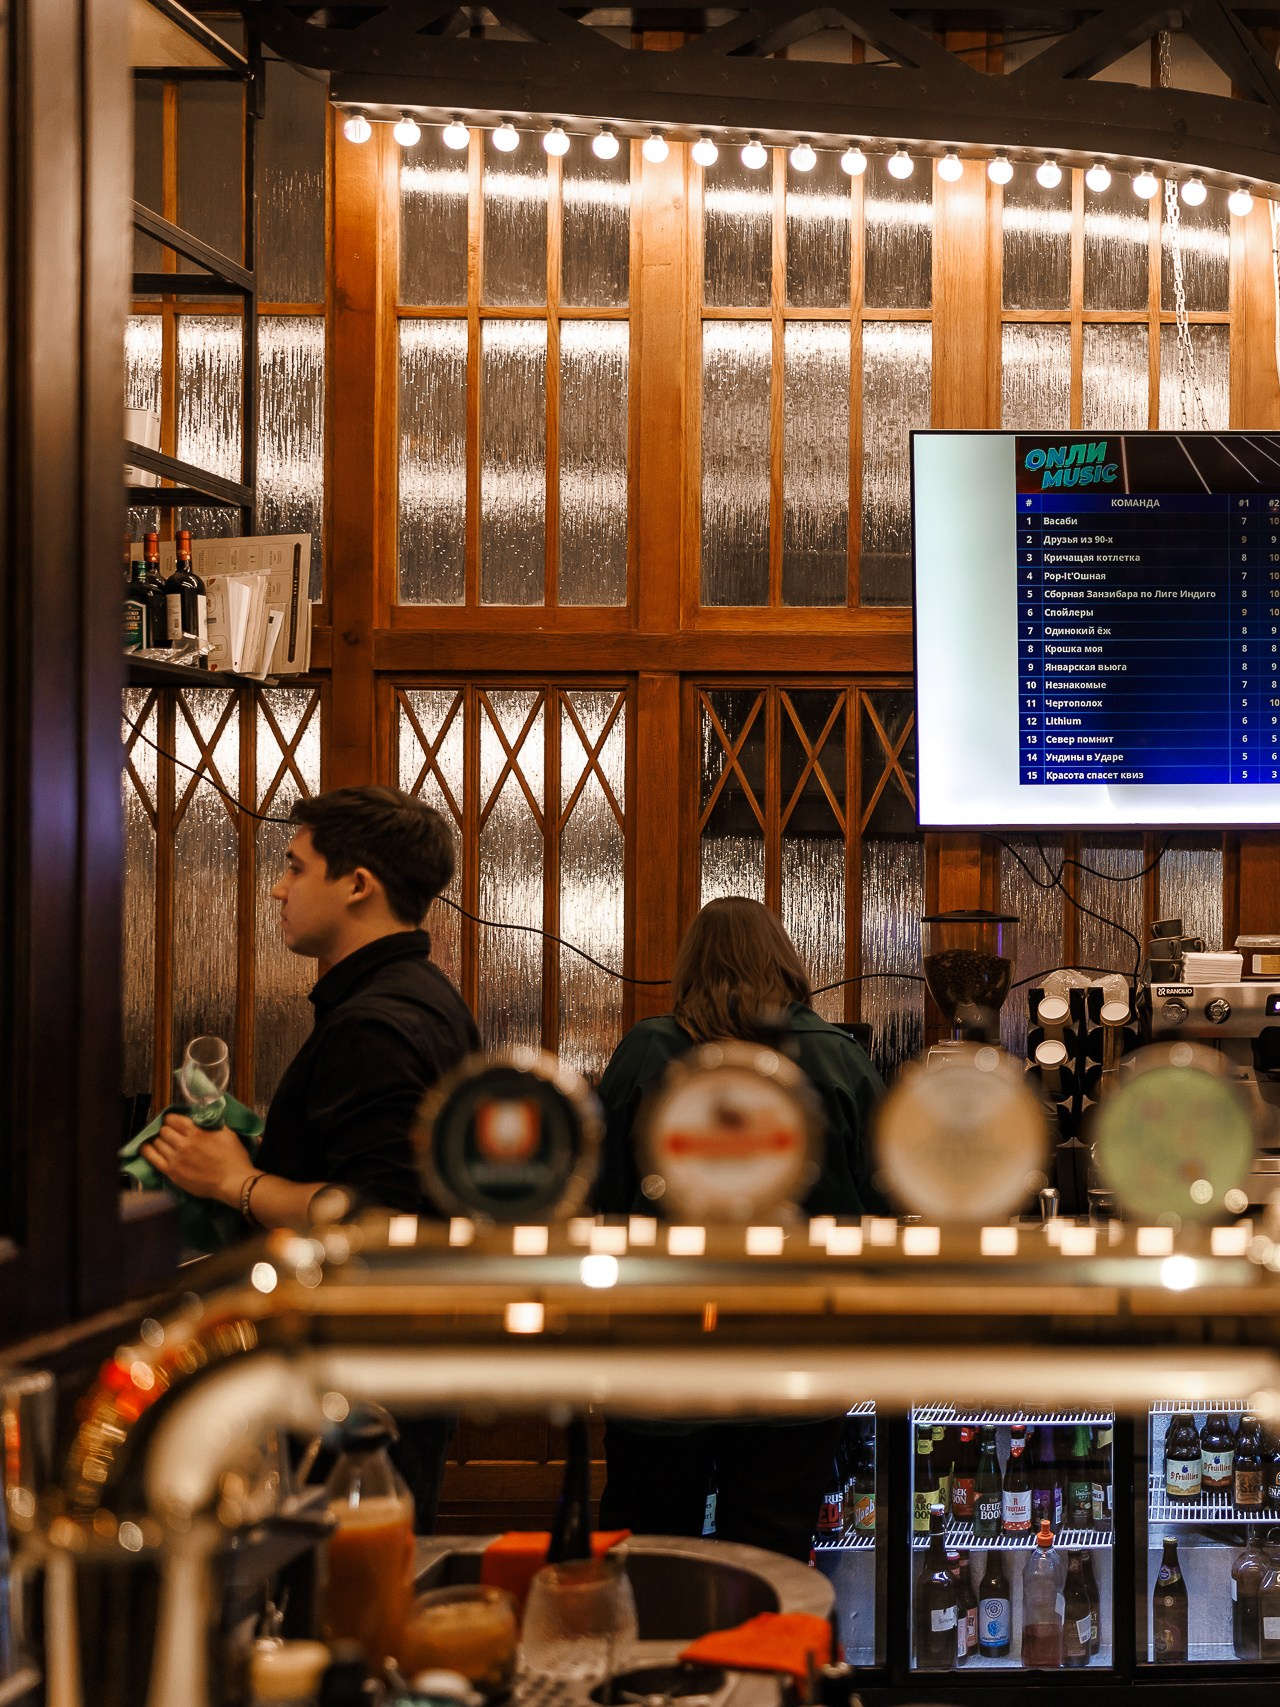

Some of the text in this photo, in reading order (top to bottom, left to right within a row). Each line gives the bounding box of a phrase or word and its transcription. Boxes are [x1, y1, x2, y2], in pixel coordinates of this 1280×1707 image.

[1041, 463, 1119, 490] MUSIC
[1025, 499, 1033, 508] #
[1111, 499, 1161, 509] КОМАНДА
[1238, 499, 1250, 508] #1
[1268, 499, 1280, 508] #2
[1026, 516, 1032, 526] 1
[1043, 516, 1078, 526] Васаби
[1241, 517, 1247, 525] 7
[1269, 517, 1280, 525] 10
[1026, 535, 1033, 544] 2
[1043, 535, 1078, 546] Друзья
[1080, 536, 1093, 544] из
[1094, 535, 1114, 544] 90-х
[1241, 535, 1247, 544] 9
[1271, 535, 1277, 544] 9
[1026, 553, 1033, 562] 3
[1043, 553, 1094, 564] Кричащая
[1096, 554, 1141, 562] котлетка
[1241, 553, 1247, 562] 8
[1269, 553, 1280, 562] 10
[1026, 571, 1033, 581] 4
[1241, 572, 1247, 580] 7
[1269, 571, 1280, 580] 10
[1027, 590, 1033, 599] 5
[1044, 589, 1085, 601] Сборная
[1086, 589, 1139, 600] Занзибара
[1154, 590, 1178, 598] Лиге
[1180, 590, 1216, 600] Индиго
[1241, 589, 1248, 598] 8
[1269, 589, 1280, 598] 10
[1027, 608, 1034, 617] 6
[1044, 607, 1094, 619] Спойлеры
[1241, 608, 1248, 617] 9
[1269, 608, 1280, 616] 10
[1027, 626, 1034, 635] 7
[1044, 625, 1095, 637] Одинокий
[1096, 626, 1112, 635] ёж
[1241, 626, 1248, 635] 8
[1271, 626, 1277, 635] 9
[1027, 644, 1034, 653] 8
[1044, 644, 1082, 655] Крошка
[1241, 644, 1248, 653] 8
[1271, 644, 1277, 653] 8
[1027, 663, 1034, 672] 9
[1044, 662, 1096, 674] Январская
[1241, 662, 1248, 671] 8
[1271, 662, 1277, 671] 9
[1025, 680, 1037, 689] 10
[1045, 680, 1107, 690] Незнакомые
[1241, 680, 1248, 689] 7
[1271, 680, 1278, 689] 8
[1026, 699, 1036, 708] 11
[1045, 699, 1103, 710] Чертополох
[1242, 698, 1248, 707] 5
[1269, 698, 1280, 707] 10
[1026, 717, 1037, 726] 12
[1045, 716, 1082, 726] Lithium
[1242, 716, 1248, 725] 6
[1271, 716, 1278, 725] 9
[1026, 735, 1038, 744] 13
[1045, 735, 1076, 746] Север
[1076, 736, 1115, 744] помнит
[1242, 734, 1248, 743] 6
[1271, 734, 1278, 743] 5
[1026, 753, 1038, 762] 14
[1045, 752, 1085, 764] Ундины
[1086, 754, 1093, 762] в
[1094, 752, 1124, 763] Ударе
[1242, 752, 1248, 761] 5
[1271, 752, 1278, 761] 6
[1027, 771, 1038, 780] 15
[1046, 771, 1085, 782] Красота
[1086, 772, 1119, 780] спасет
[1242, 770, 1248, 779] 5
[1271, 770, 1278, 779] 3
